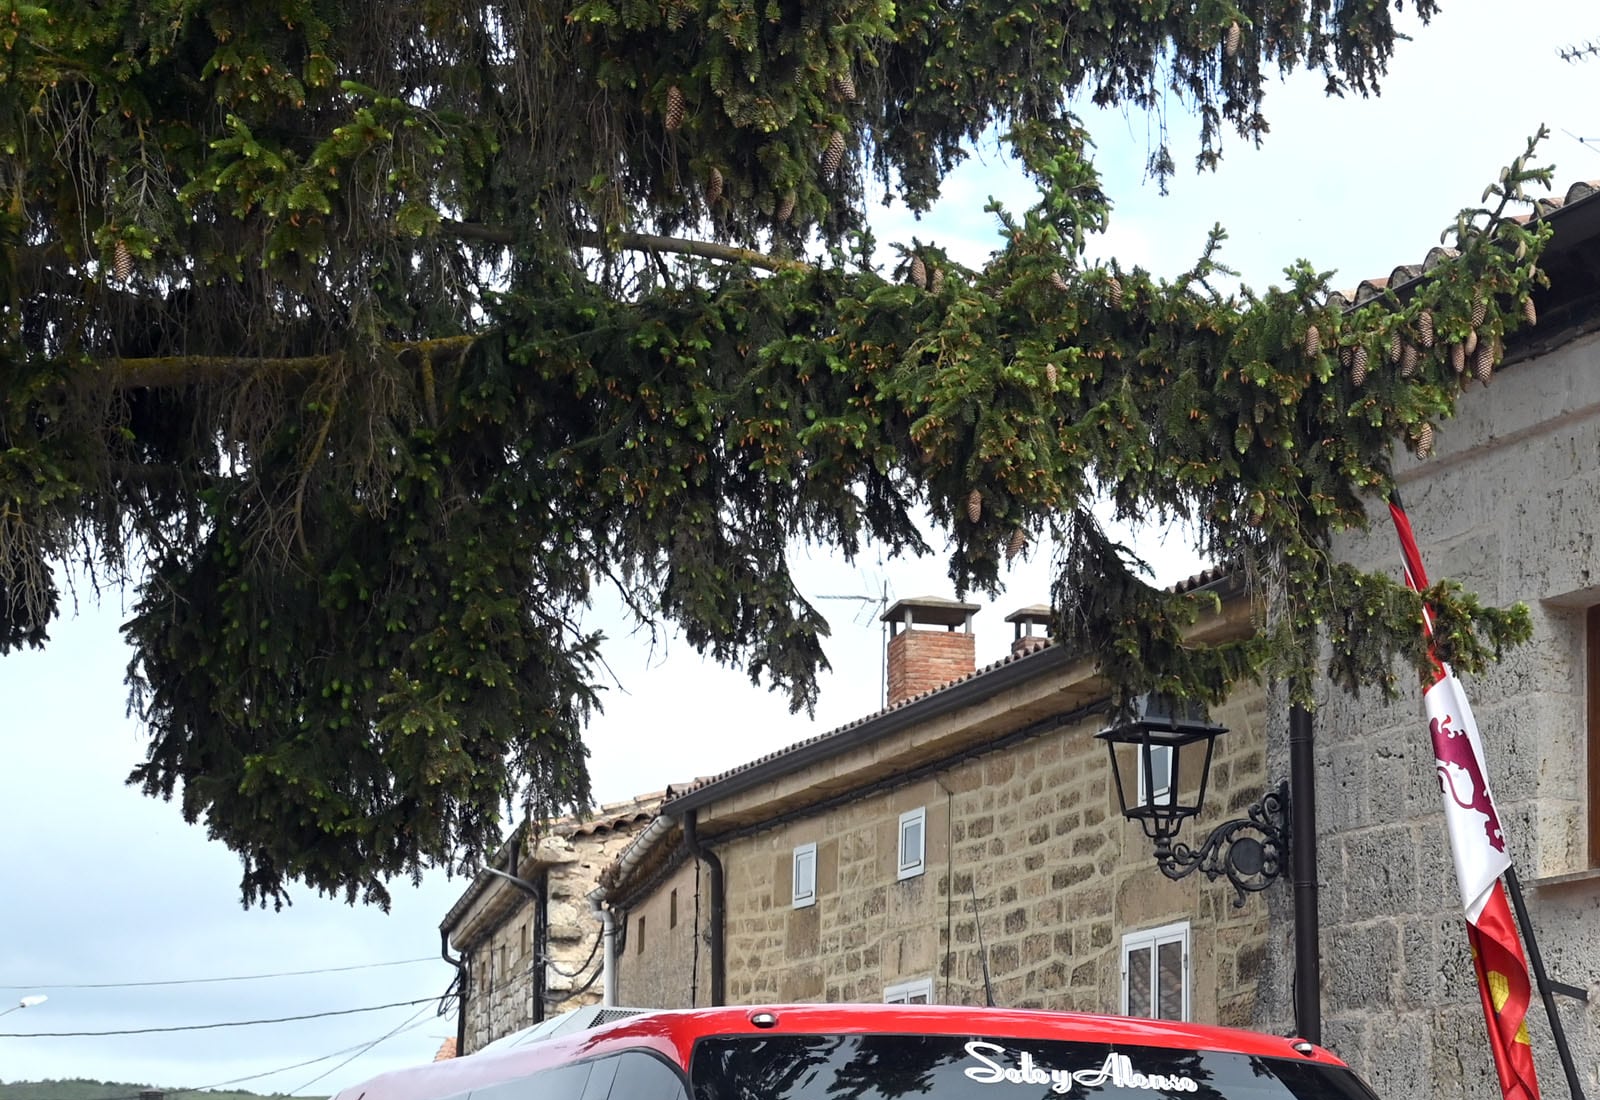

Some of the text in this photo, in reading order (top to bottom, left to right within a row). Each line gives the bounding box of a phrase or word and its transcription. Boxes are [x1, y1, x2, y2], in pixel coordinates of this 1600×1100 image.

[964, 1041, 1198, 1094] Soto y Alonso
